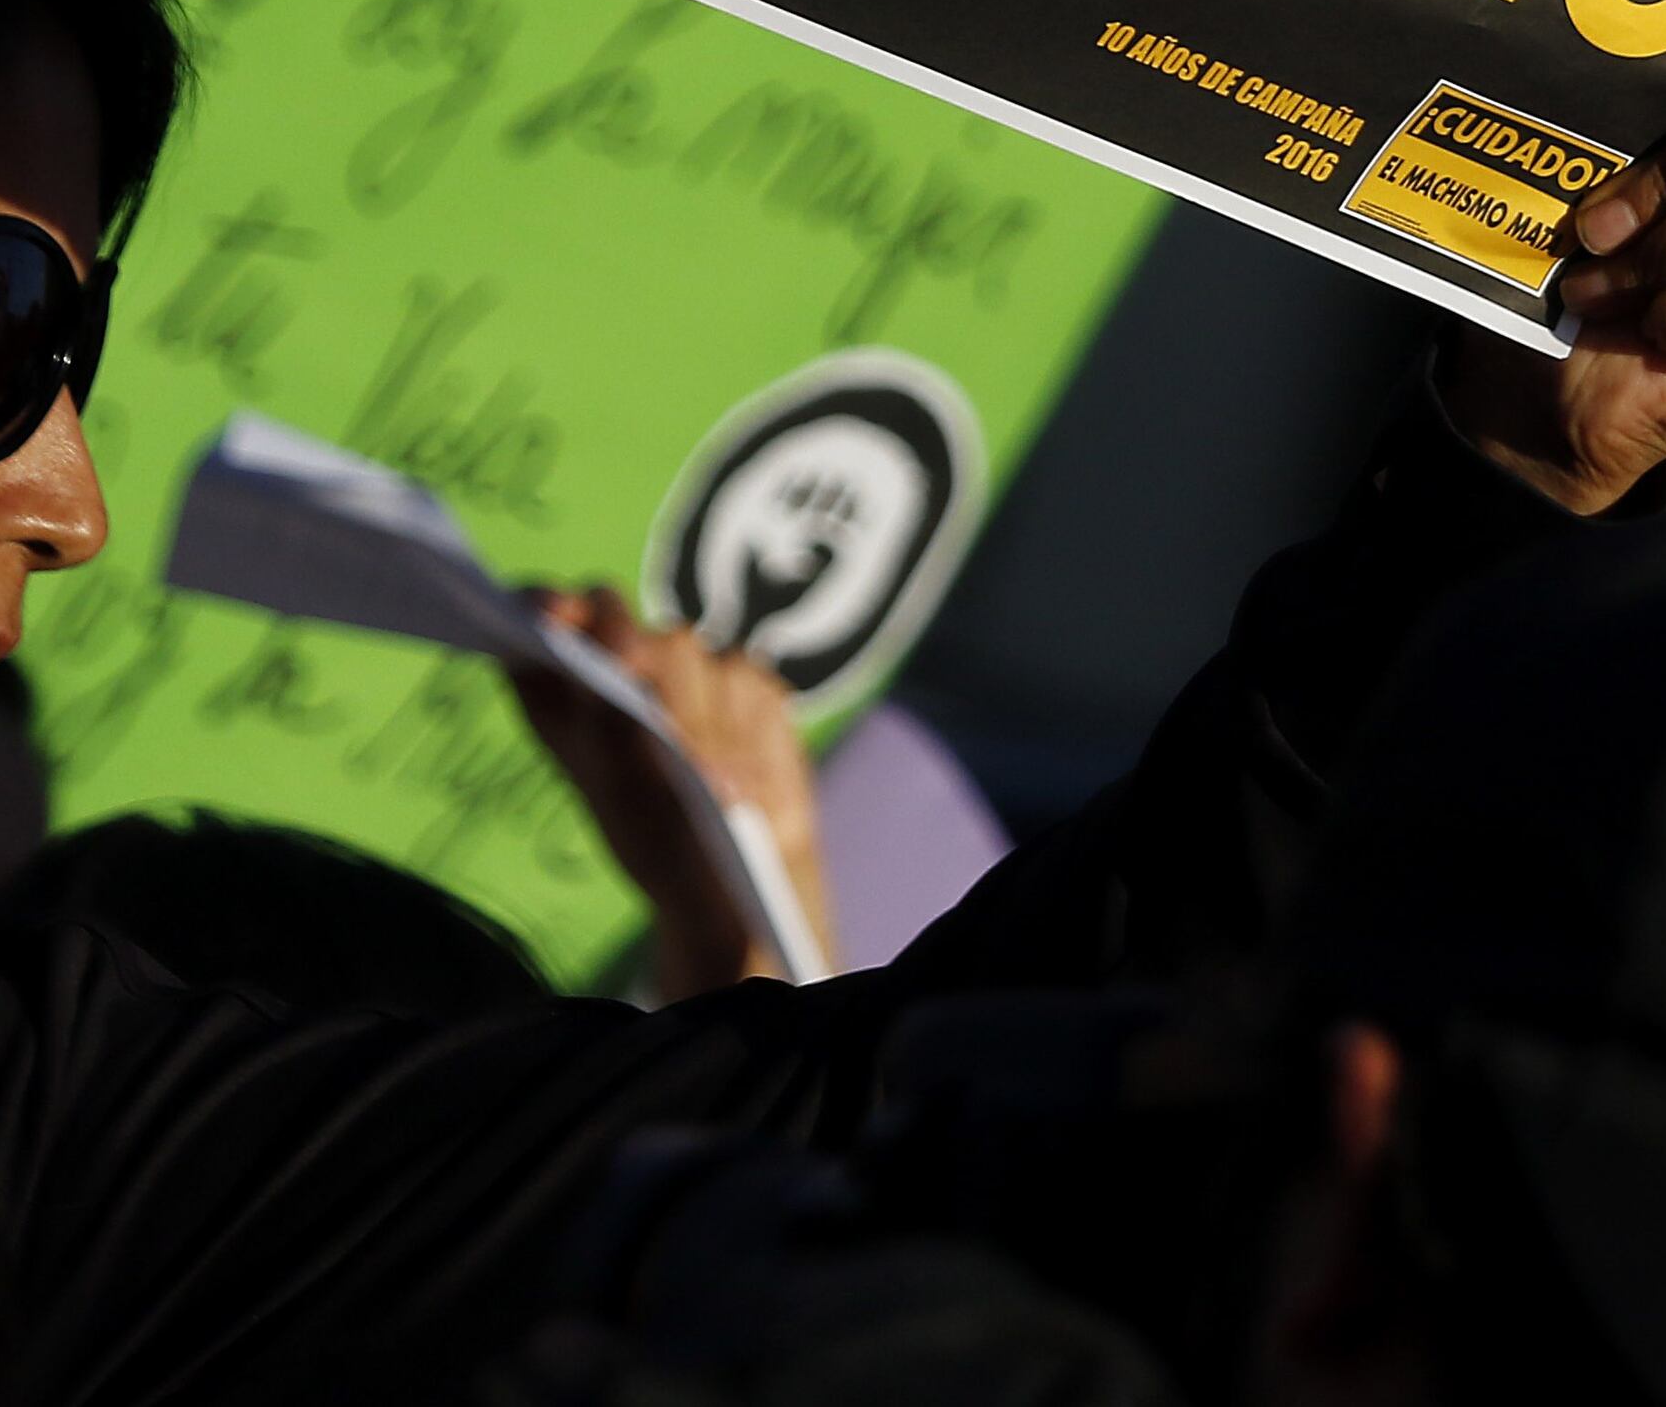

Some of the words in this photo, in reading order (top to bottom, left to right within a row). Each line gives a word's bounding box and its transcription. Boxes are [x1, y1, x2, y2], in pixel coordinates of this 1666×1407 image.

[1096, 21, 1130, 53] 10
[1129, 34, 1200, 81] AÑOS
[1198, 60, 1243, 97] DE
[1234, 75, 1365, 147] CAMPAÑA
[1265, 133, 1338, 183] 2016
[1378, 155, 1399, 183] EL
[1400, 164, 1507, 228] MACHISMO
